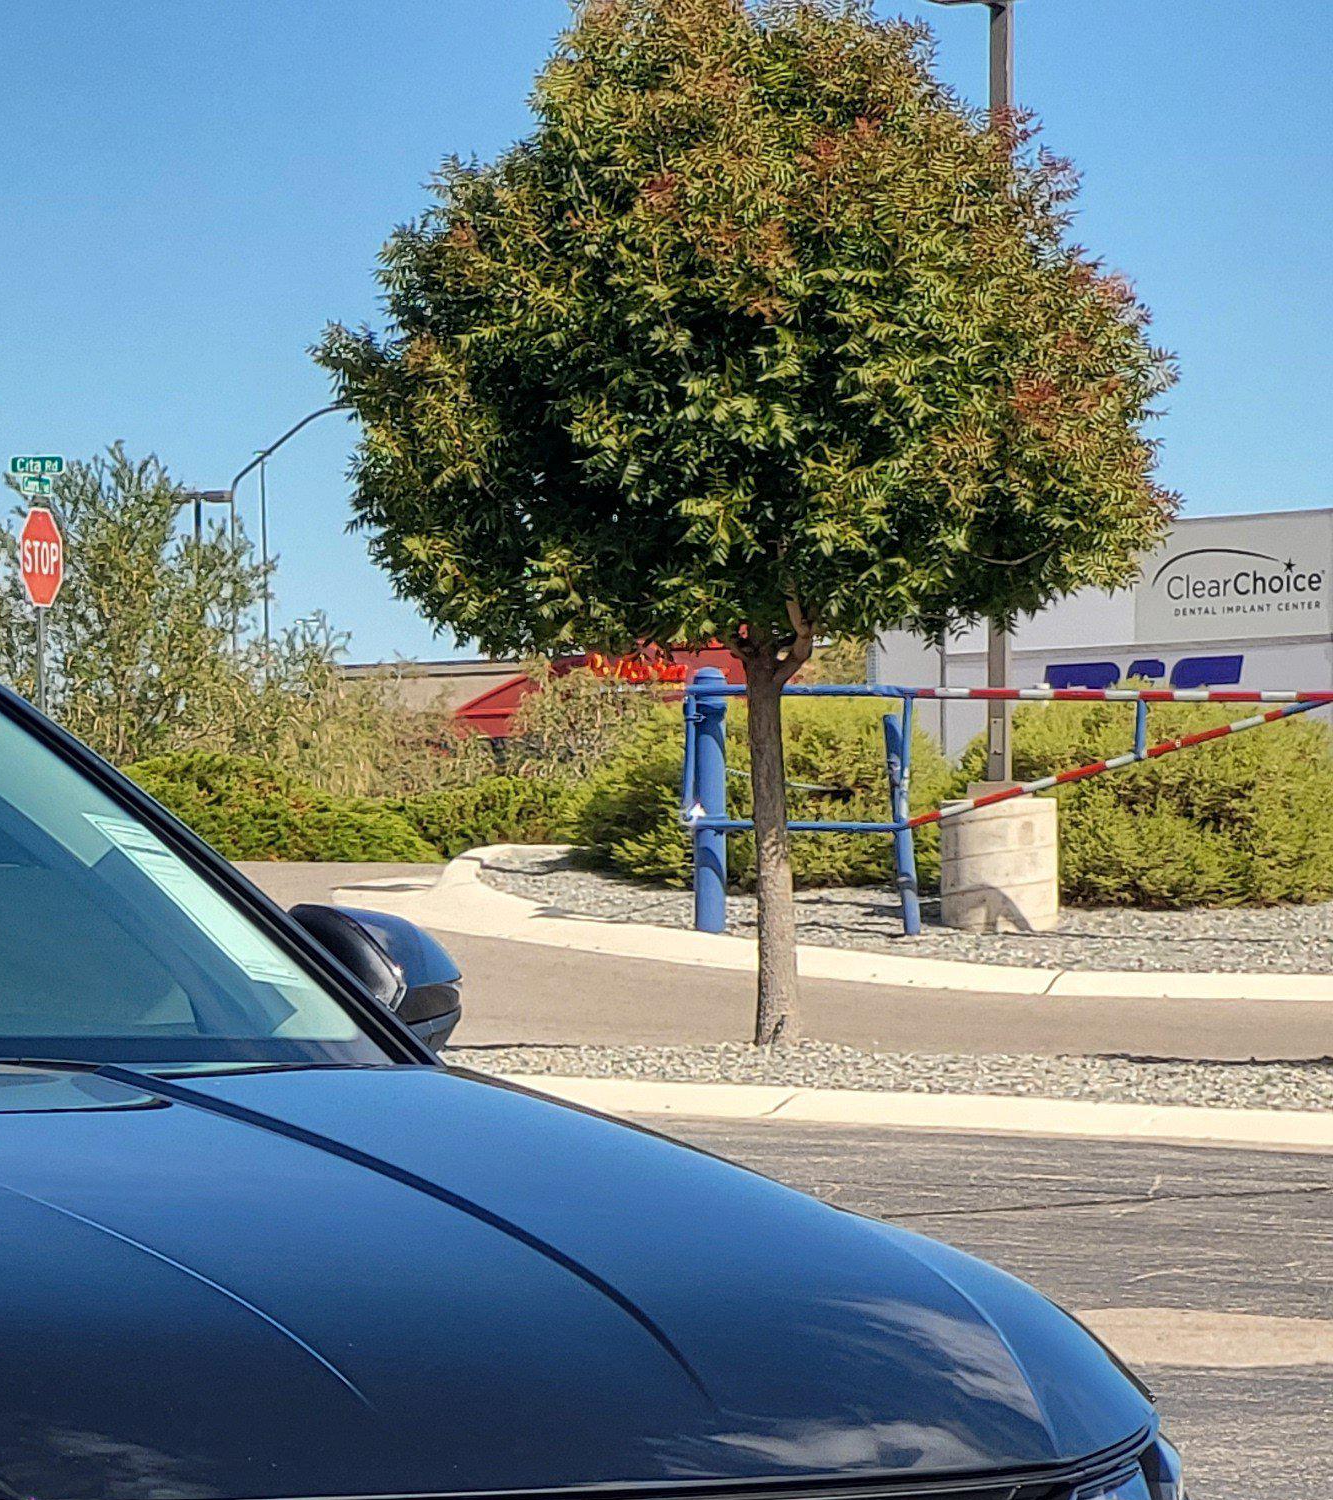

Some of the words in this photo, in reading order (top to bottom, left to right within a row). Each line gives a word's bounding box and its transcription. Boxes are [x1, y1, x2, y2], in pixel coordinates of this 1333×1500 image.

[23, 539, 59, 575] STOP
[1167, 570, 1322, 600] ClearChoice
[1174, 605, 1217, 617] DENTAL
[1222, 603, 1271, 615] IMPLANT
[1277, 601, 1321, 612] CENTER
